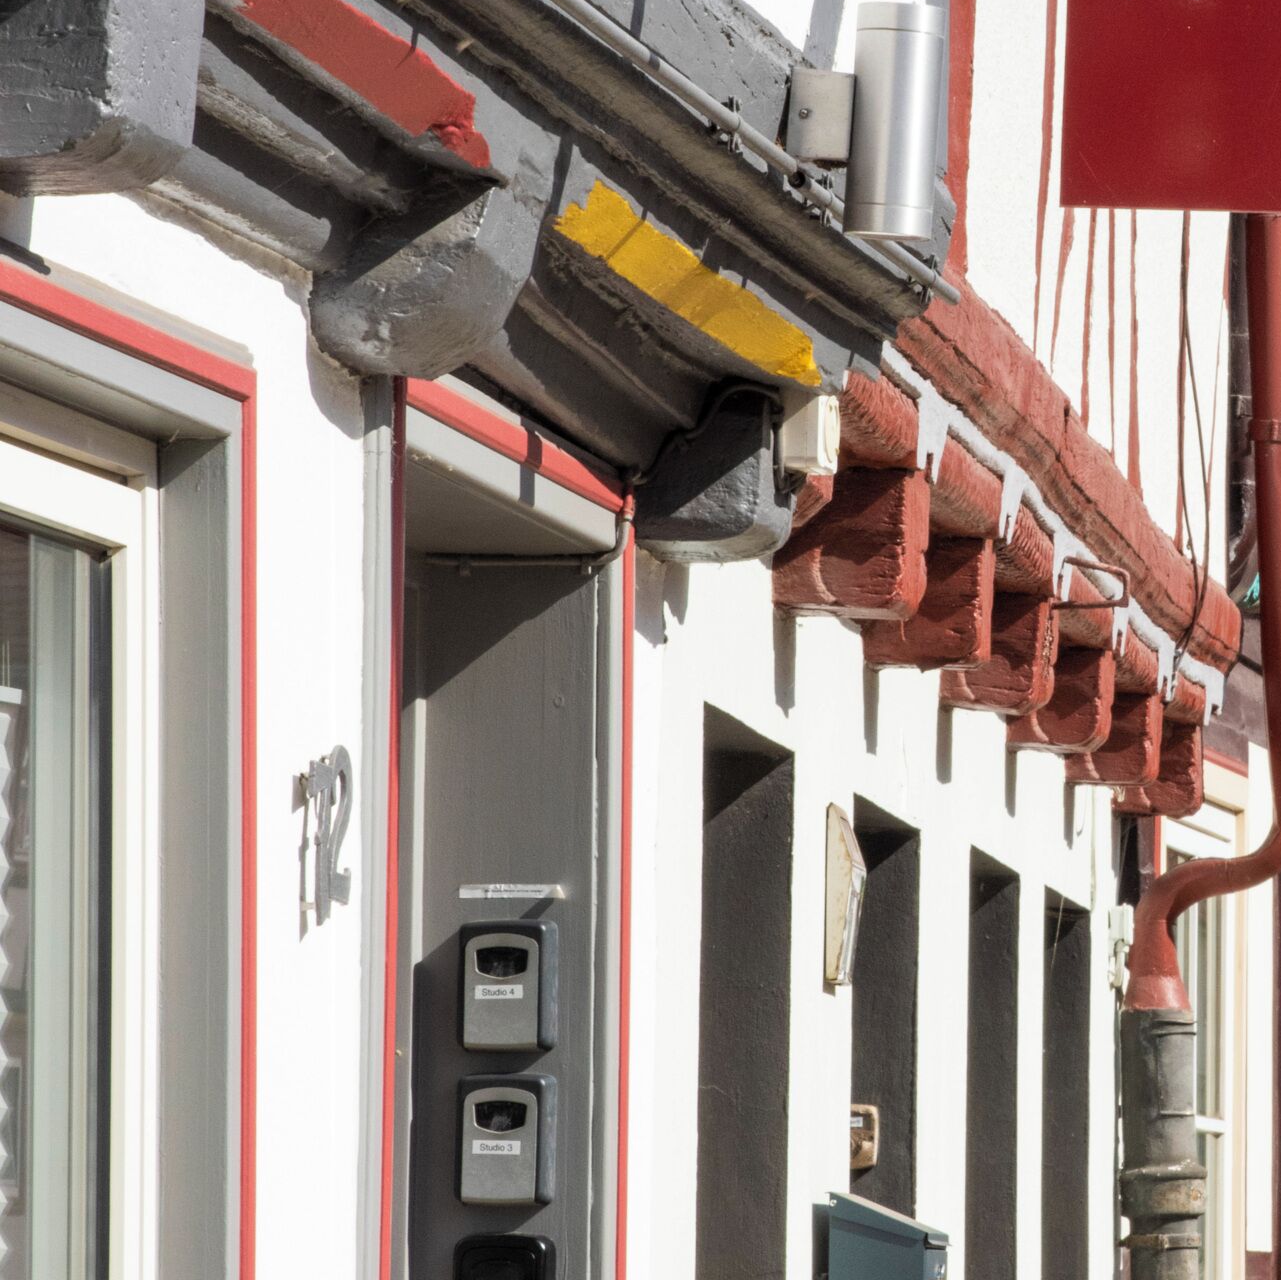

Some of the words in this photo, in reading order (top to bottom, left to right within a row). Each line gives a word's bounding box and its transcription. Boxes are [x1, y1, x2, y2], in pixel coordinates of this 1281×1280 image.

[481, 987, 508, 997] Studio
[508, 987, 516, 997] 4
[479, 1142, 506, 1152] Studio
[506, 1142, 513, 1152] 3
